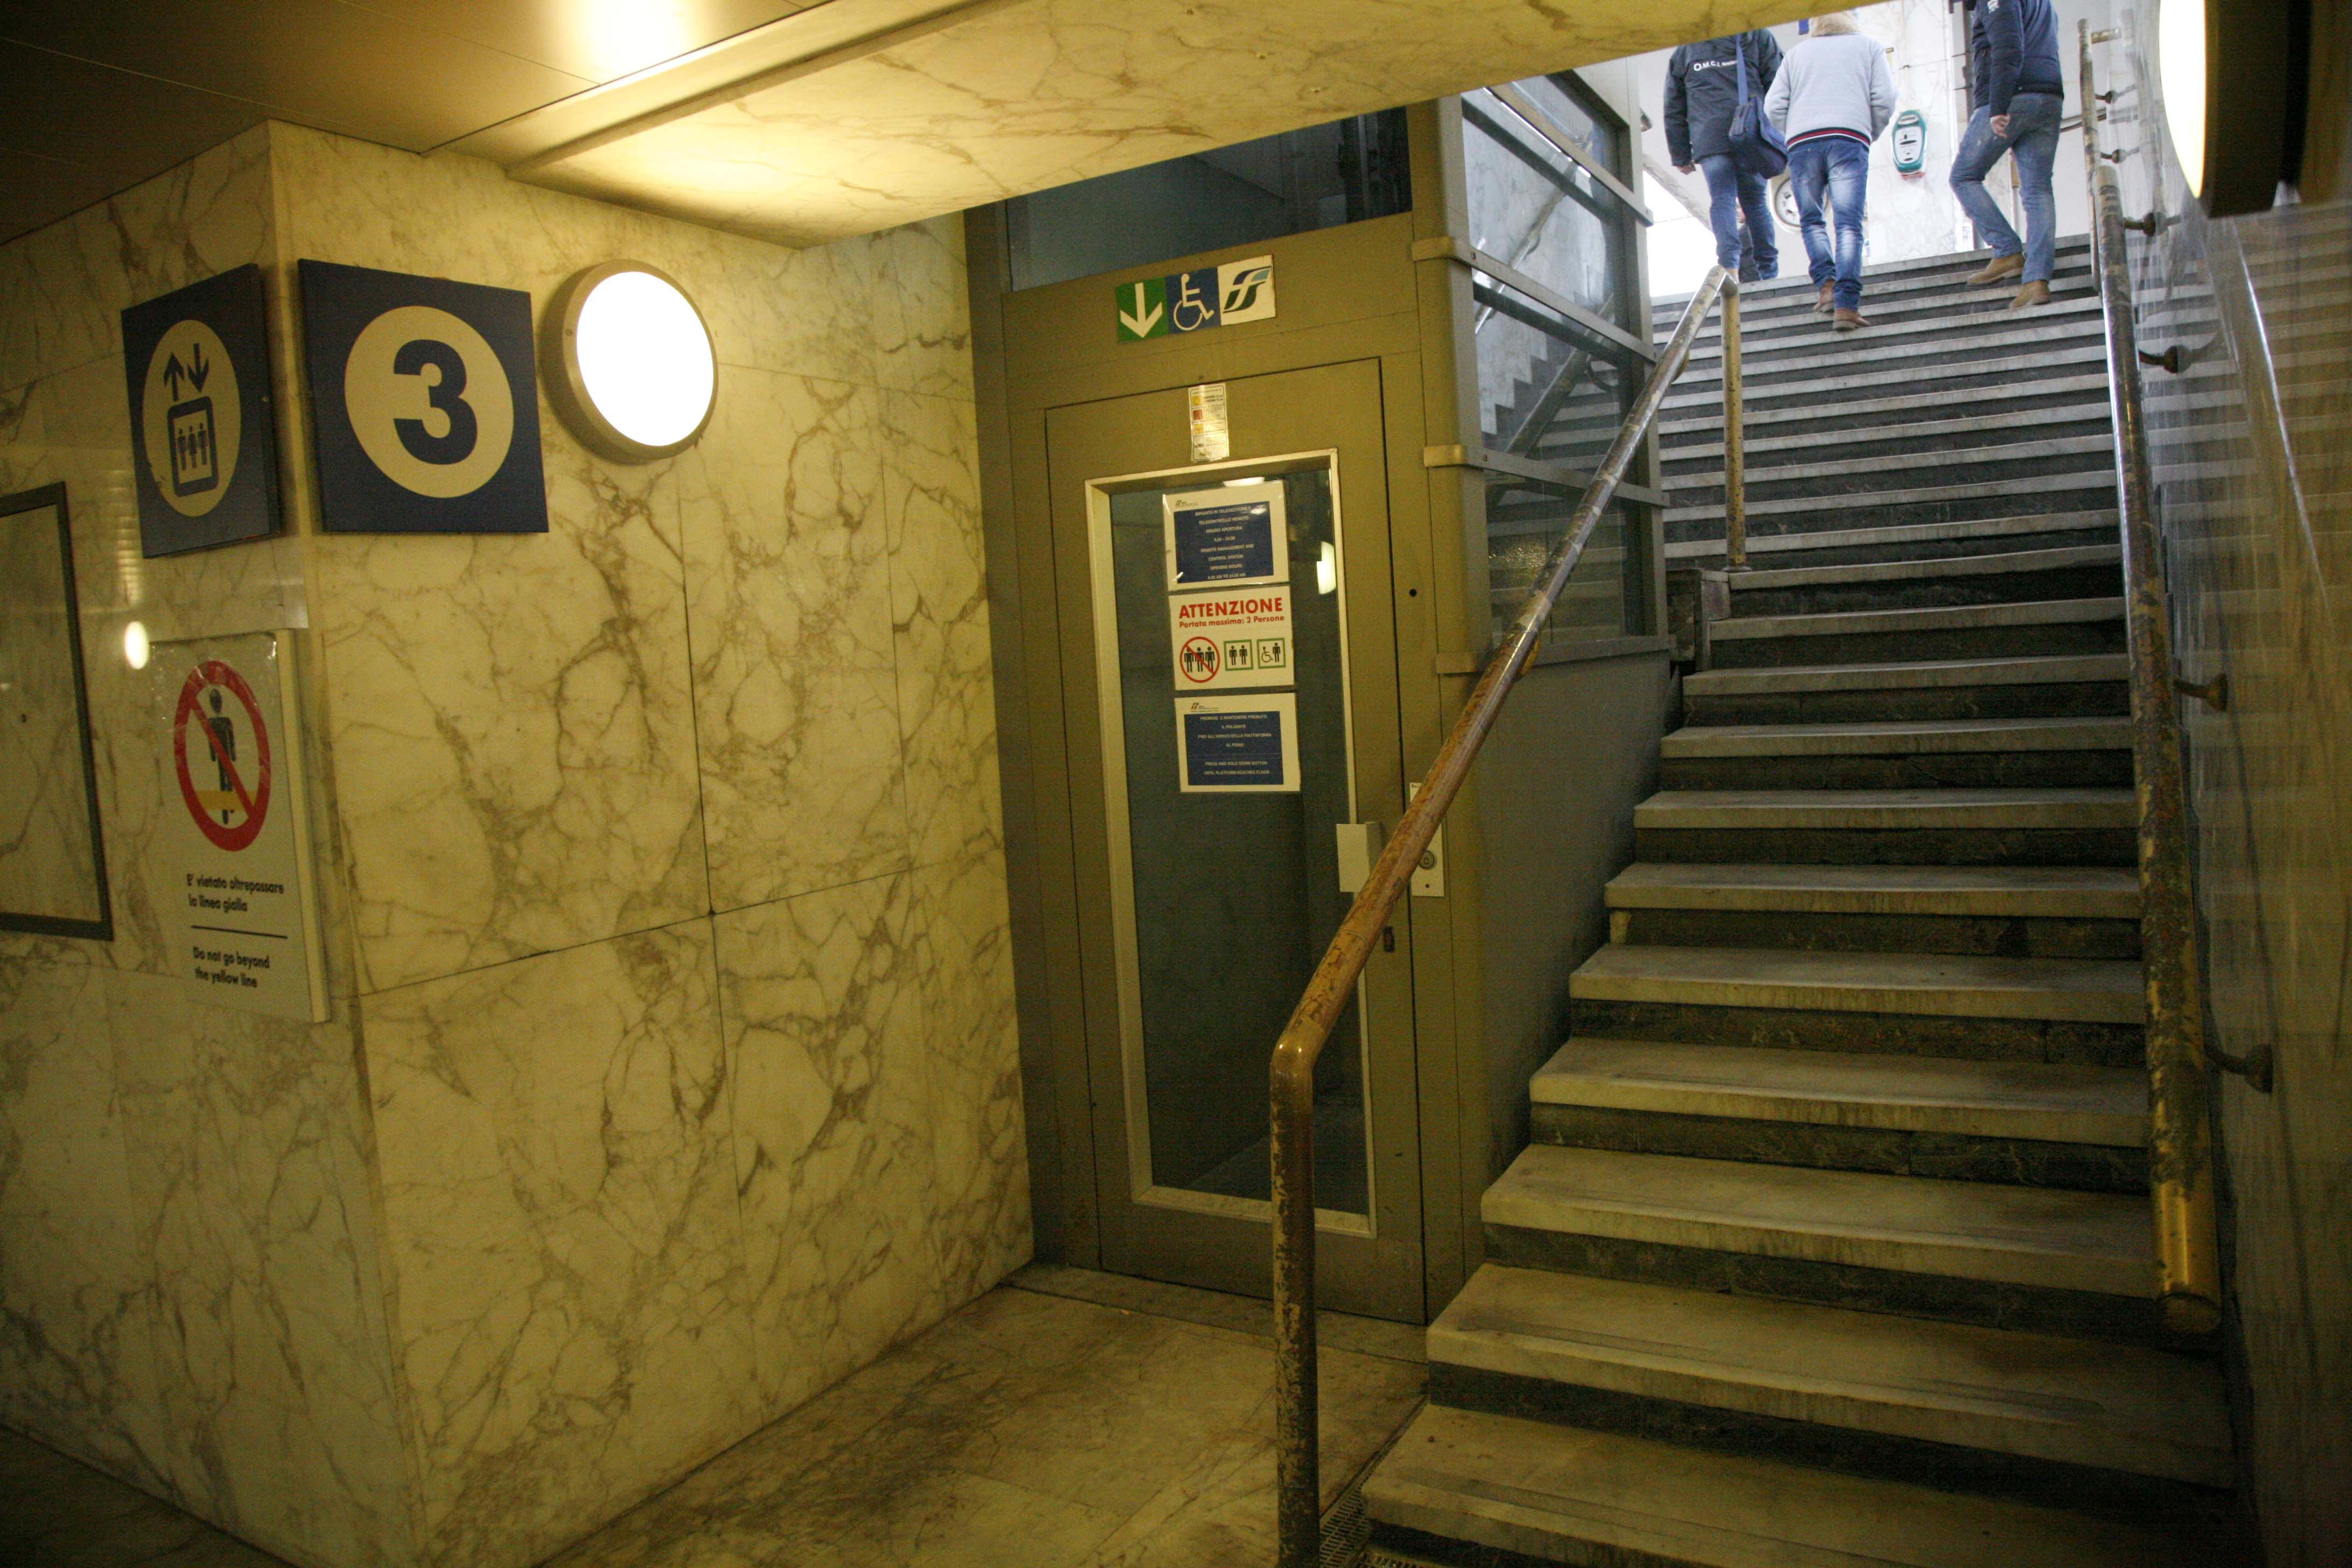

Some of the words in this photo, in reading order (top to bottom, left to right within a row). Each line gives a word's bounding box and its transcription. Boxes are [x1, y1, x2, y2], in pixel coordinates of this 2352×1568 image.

[393, 339, 478, 465] 3
[1179, 598, 1283, 619] ATTENZIONE
[1208, 618, 1244, 626] massima:
[1254, 615, 1285, 623] Persone
[197, 874, 227, 888] vietato
[230, 876, 284, 895] oltrepassare
[188, 893, 197, 907] la
[199, 894, 220, 909] linea
[223, 897, 248, 913] gialla
[193, 946, 205, 960] Do
[207, 950, 221, 961] not
[223, 954, 235, 966] go
[237, 951, 269, 969] beyond
[195, 967, 209, 981] the
[211, 970, 239, 984] yellow
[241, 972, 257, 988] line
